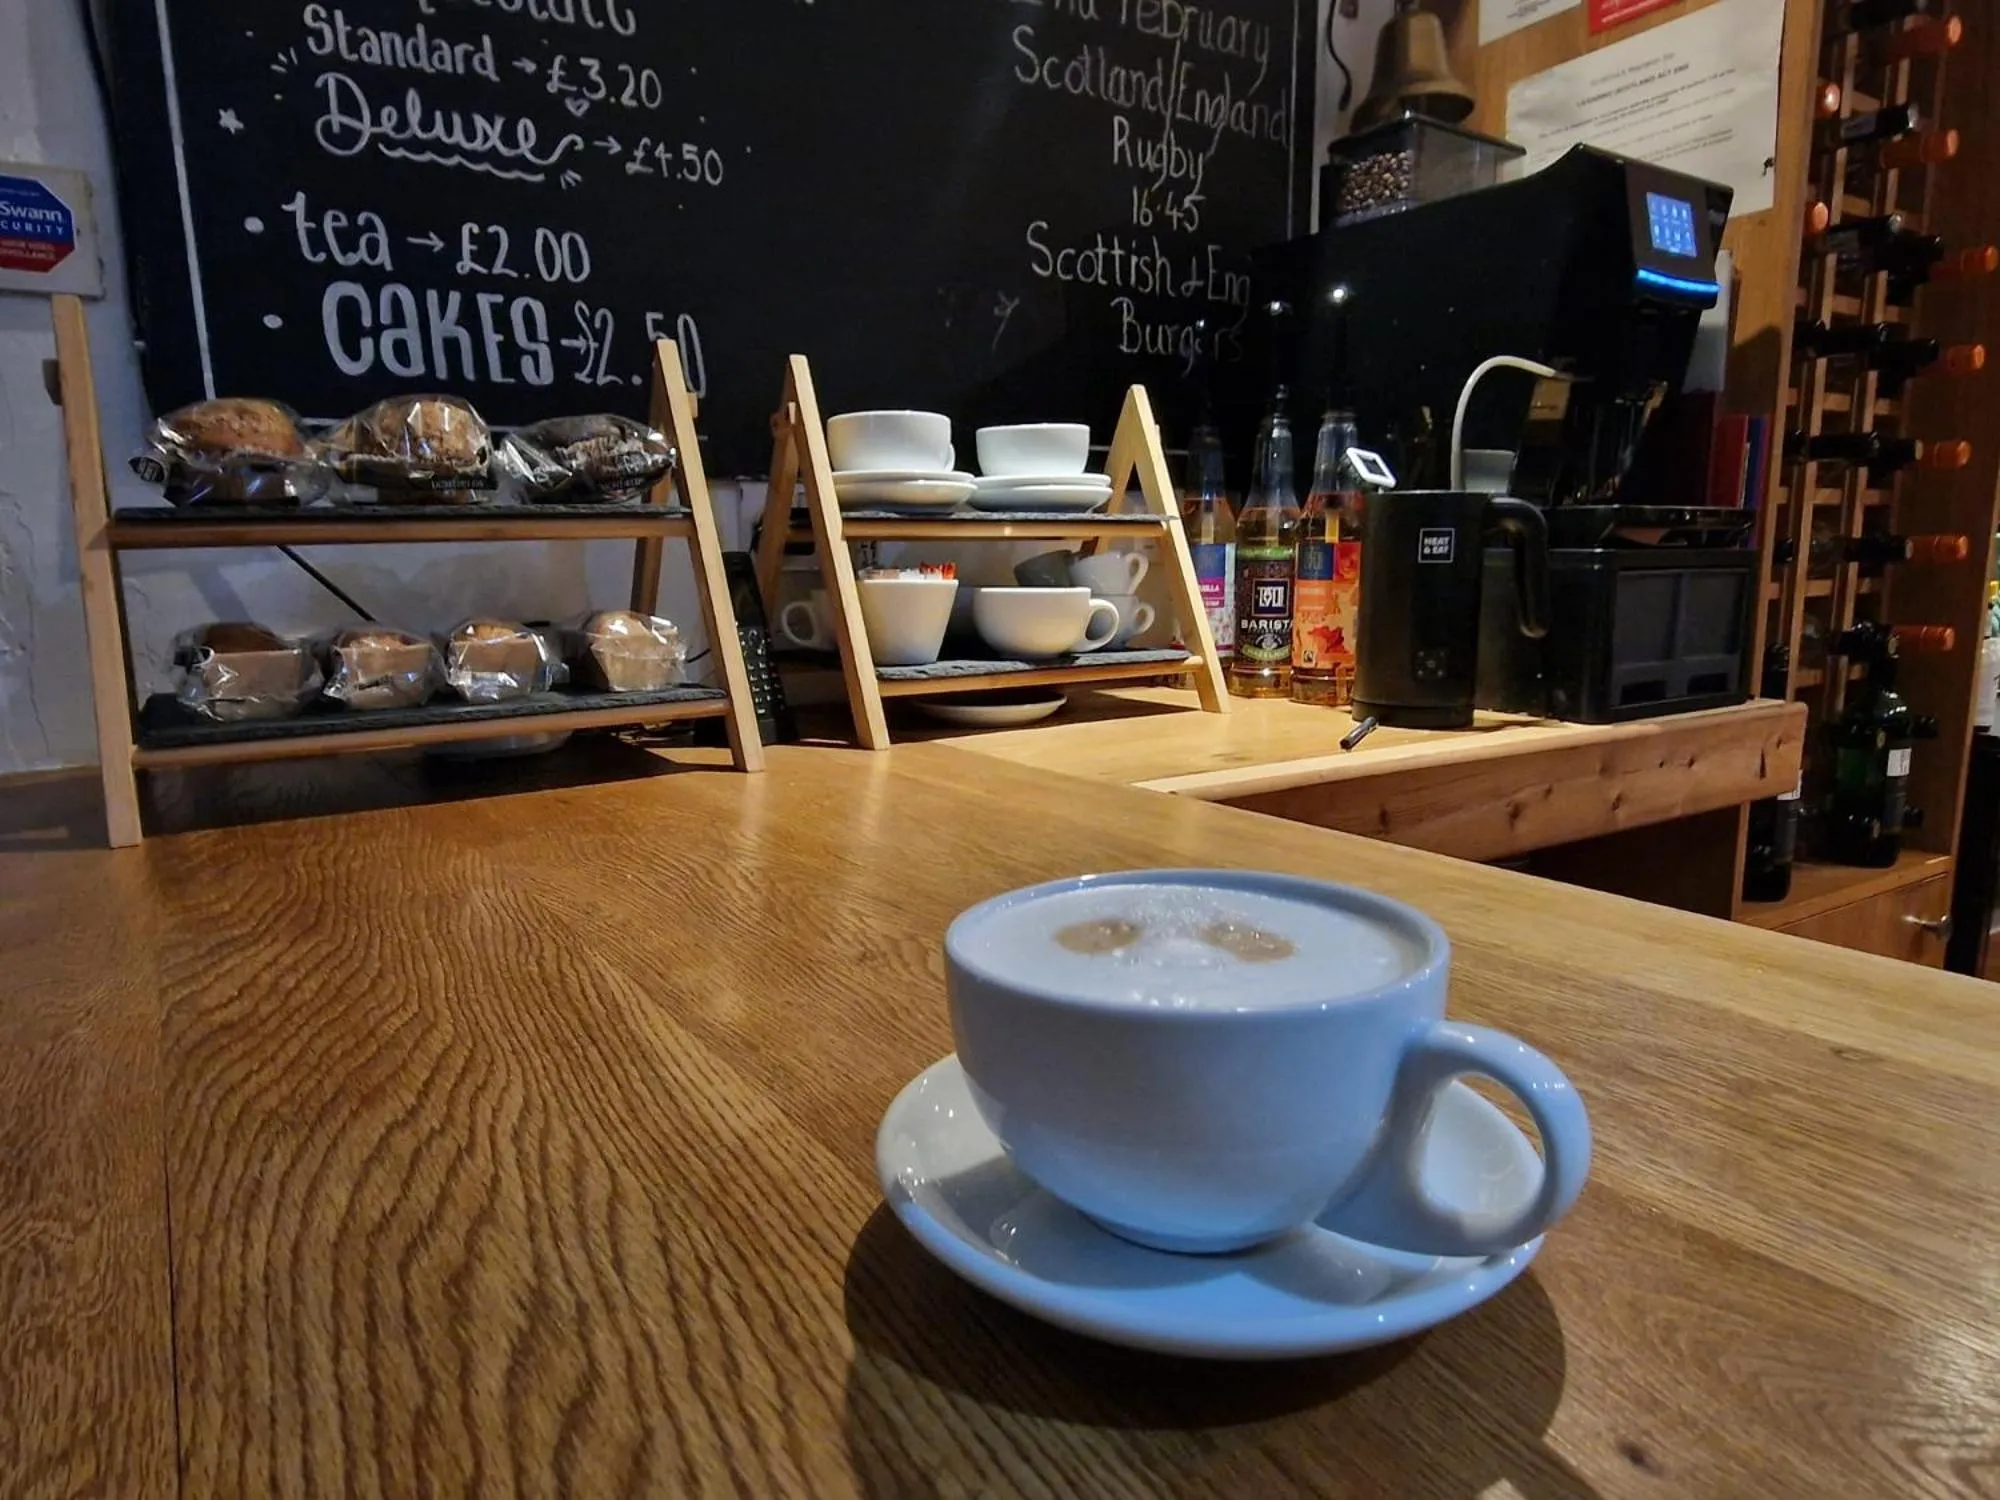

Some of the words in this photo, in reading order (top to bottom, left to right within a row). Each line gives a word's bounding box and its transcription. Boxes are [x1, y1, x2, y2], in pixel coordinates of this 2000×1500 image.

[303, 4, 500, 81] Standard
[546, 56, 662, 109] £3.20
[314, 71, 585, 165] Deluxe
[625, 137, 723, 186] £4.50
[1112, 115, 1205, 197] Rugby
[0, 200, 63, 223] Swann
[281, 191, 393, 271] tea
[455, 229, 590, 283] £2.00
[1026, 221, 1175, 297] Scottish
